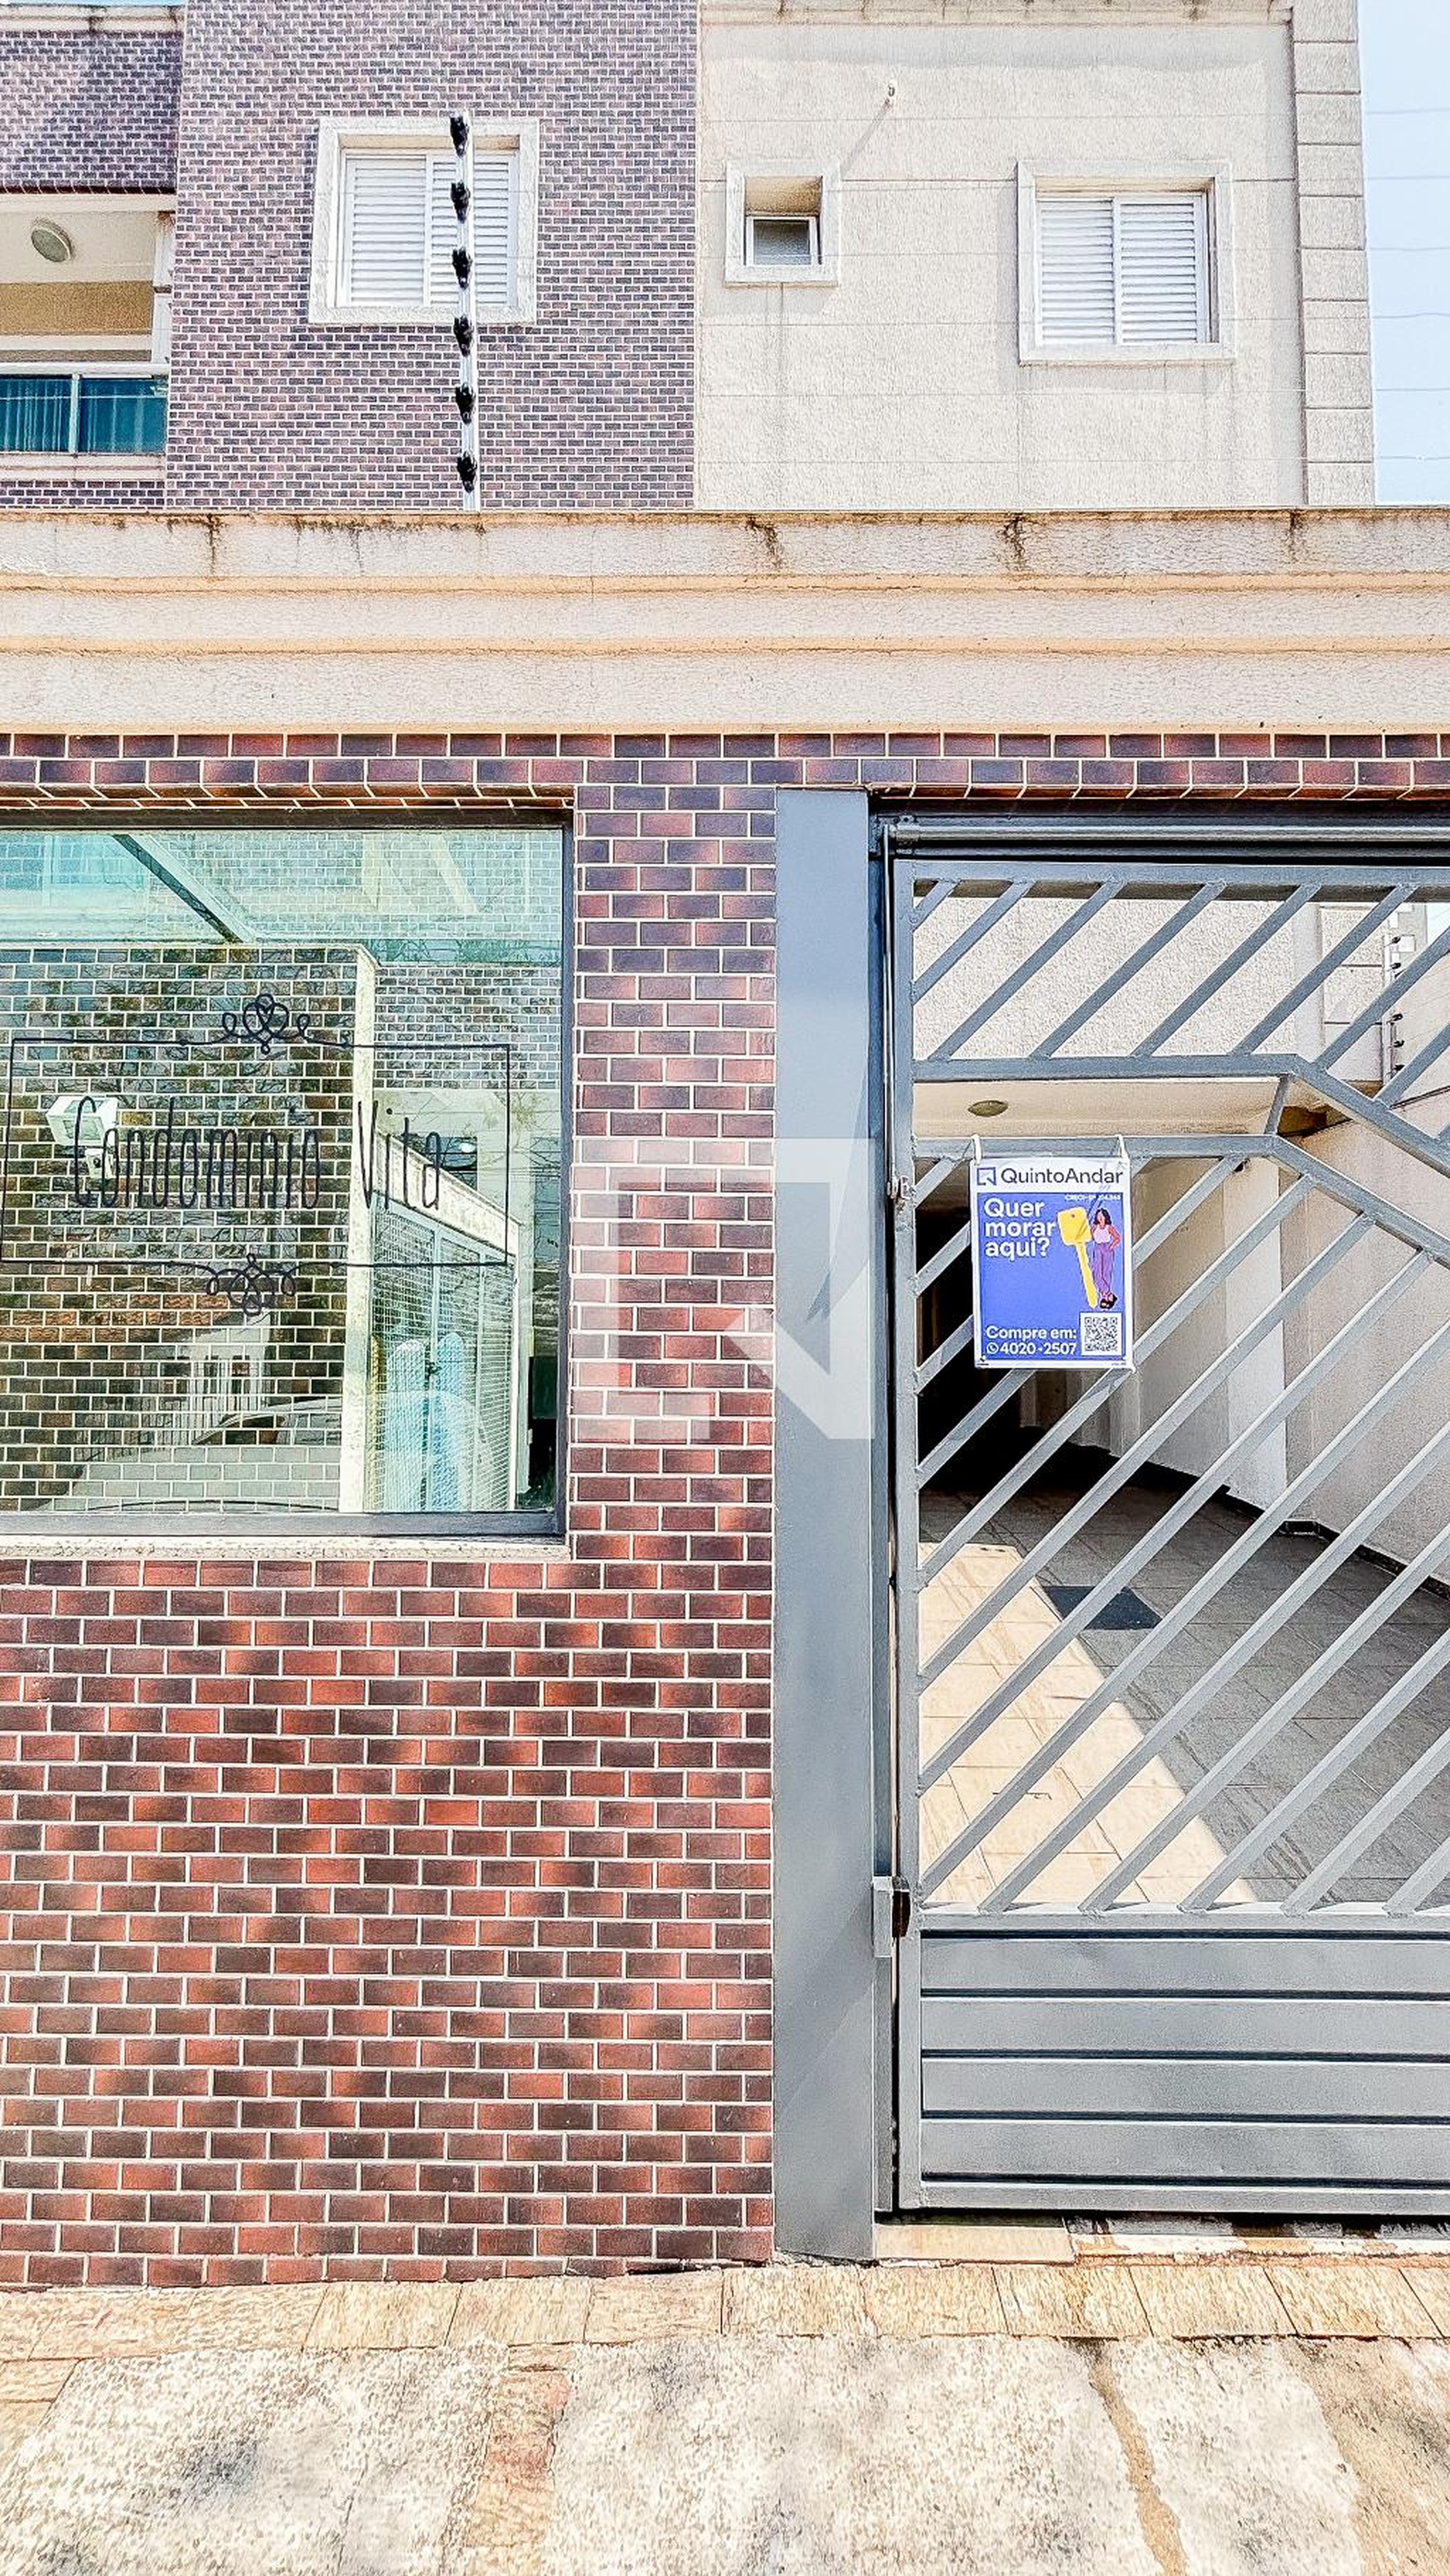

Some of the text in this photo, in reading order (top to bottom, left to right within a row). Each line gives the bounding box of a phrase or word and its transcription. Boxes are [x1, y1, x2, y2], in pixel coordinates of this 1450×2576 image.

[358, 1100, 441, 1210] Vita
[1001, 1167, 1123, 1184] QuintoAndar
[984, 1198, 1045, 1218] Quer
[985, 1221, 1056, 1237] morar
[985, 1237, 1050, 1261] aqui?
[986, 1325, 1077, 1341] Compre em:
